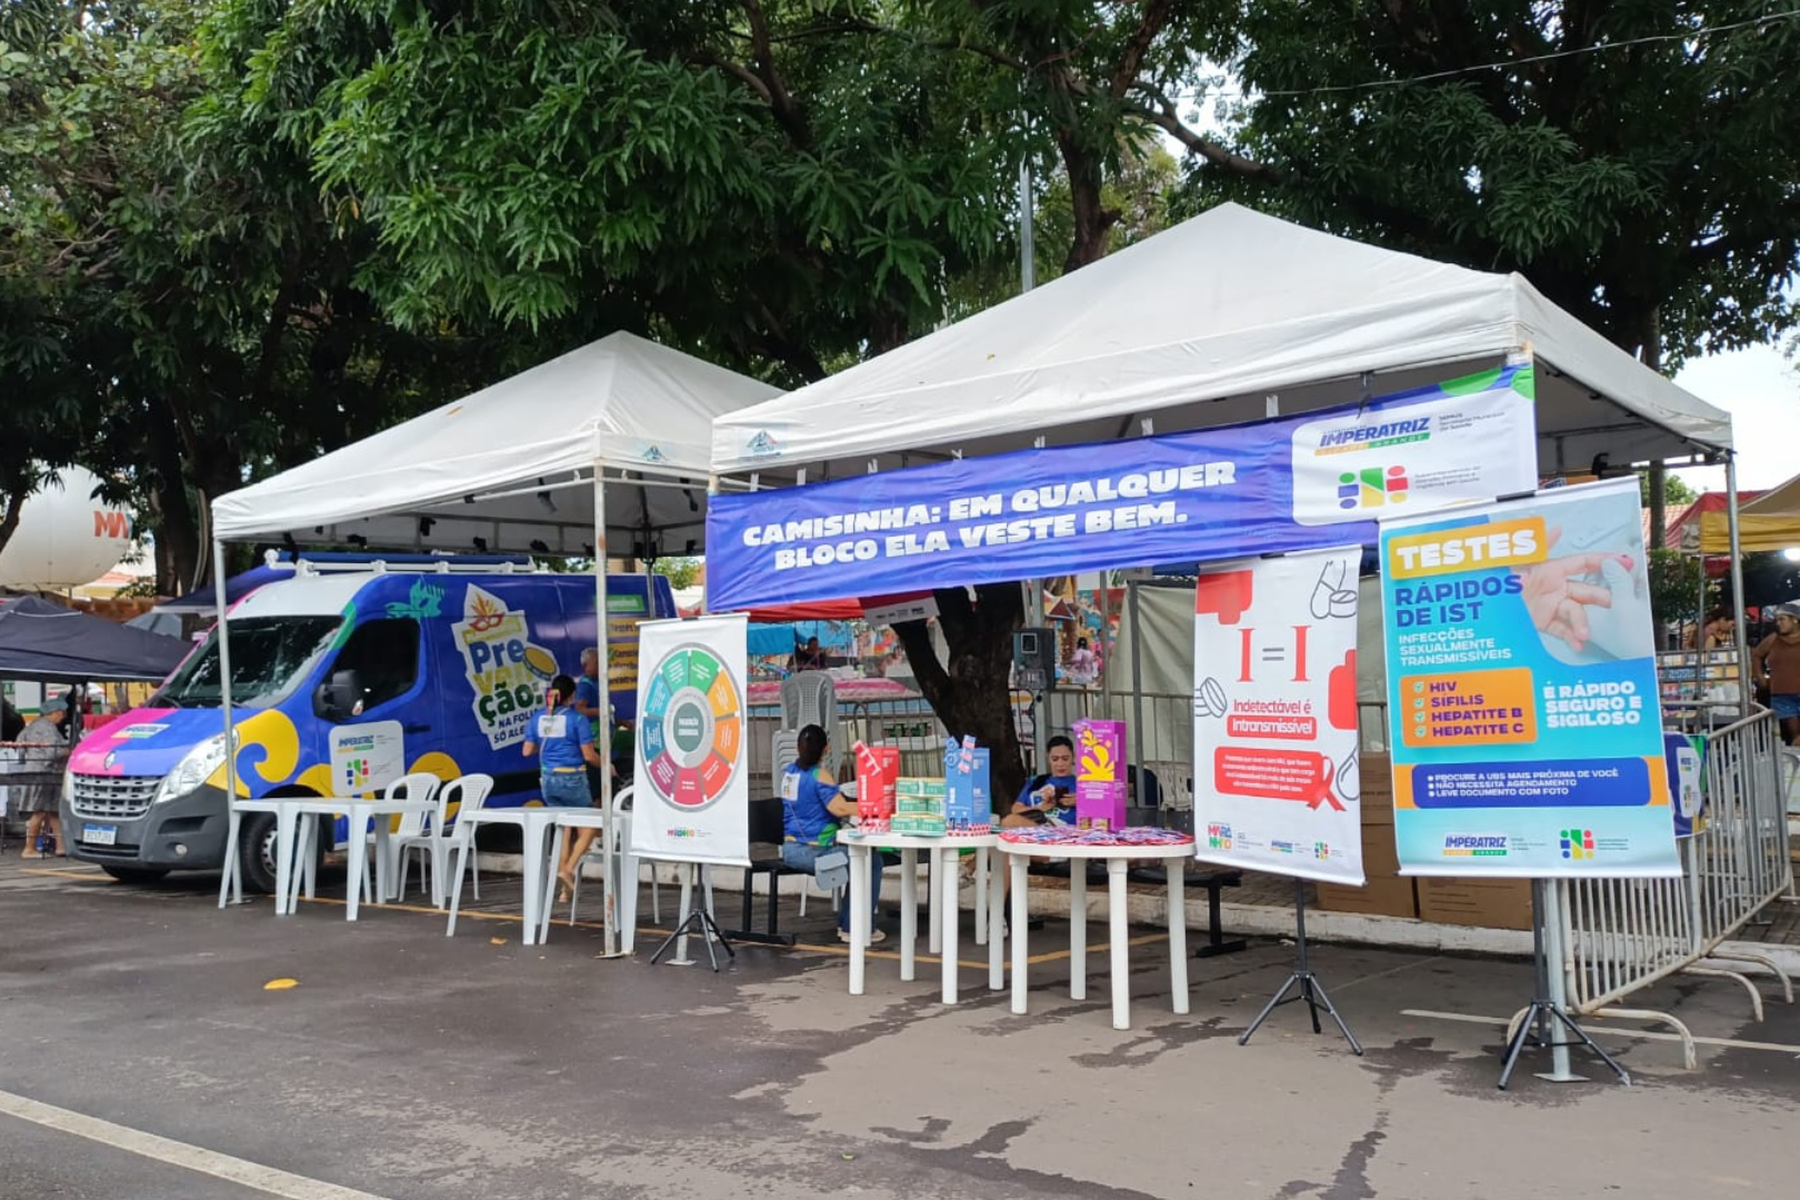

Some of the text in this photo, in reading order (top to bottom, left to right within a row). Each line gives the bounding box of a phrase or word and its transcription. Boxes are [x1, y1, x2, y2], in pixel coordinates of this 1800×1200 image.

[1319, 417, 1431, 447] IMPERATRIZ
[743, 461, 1237, 547] CAMISINHA: EM QUALQUER
[774, 501, 1188, 570] BLOCO ELA VESTE BEM.
[1396, 529, 1537, 570] TESTES
[1395, 575, 1523, 606] RÁPIDOS
[1396, 601, 1484, 628] DE IST
[1398, 627, 1474, 645] INFECÇÕES
[469, 639, 525, 673] Pre
[1400, 638, 1495, 656] SEXUALMENTE
[1401, 648, 1512, 667] TRANSMISSÍVEIS
[1430, 681, 1457, 692] HIV
[1543, 680, 1635, 699] É RÁPIDO
[1234, 698, 1311, 714] Indetectável é
[1431, 693, 1484, 708] SÍFILIS
[1545, 696, 1642, 713] SEGURO E
[1432, 707, 1522, 722] HEPATITE B
[1547, 711, 1641, 728] SIGILOSO
[1233, 717, 1312, 735] Intransmissível
[1433, 722, 1524, 737] HEPATITE C
[1435, 773, 1477, 781] PROCURE
[1507, 771, 1531, 779] MAIS
[1533, 768, 1576, 779] PRÓXIMA
[1577, 769, 1590, 778] DE
[1592, 767, 1619, 778] VOCÊ
[1435, 779, 1577, 790] NÃO NECESSITA AGENDAMENTO
[1436, 787, 1569, 797] LEVE DOCUMENTO COM FOTO
[1445, 836, 1507, 848] IMPERATRIZ
